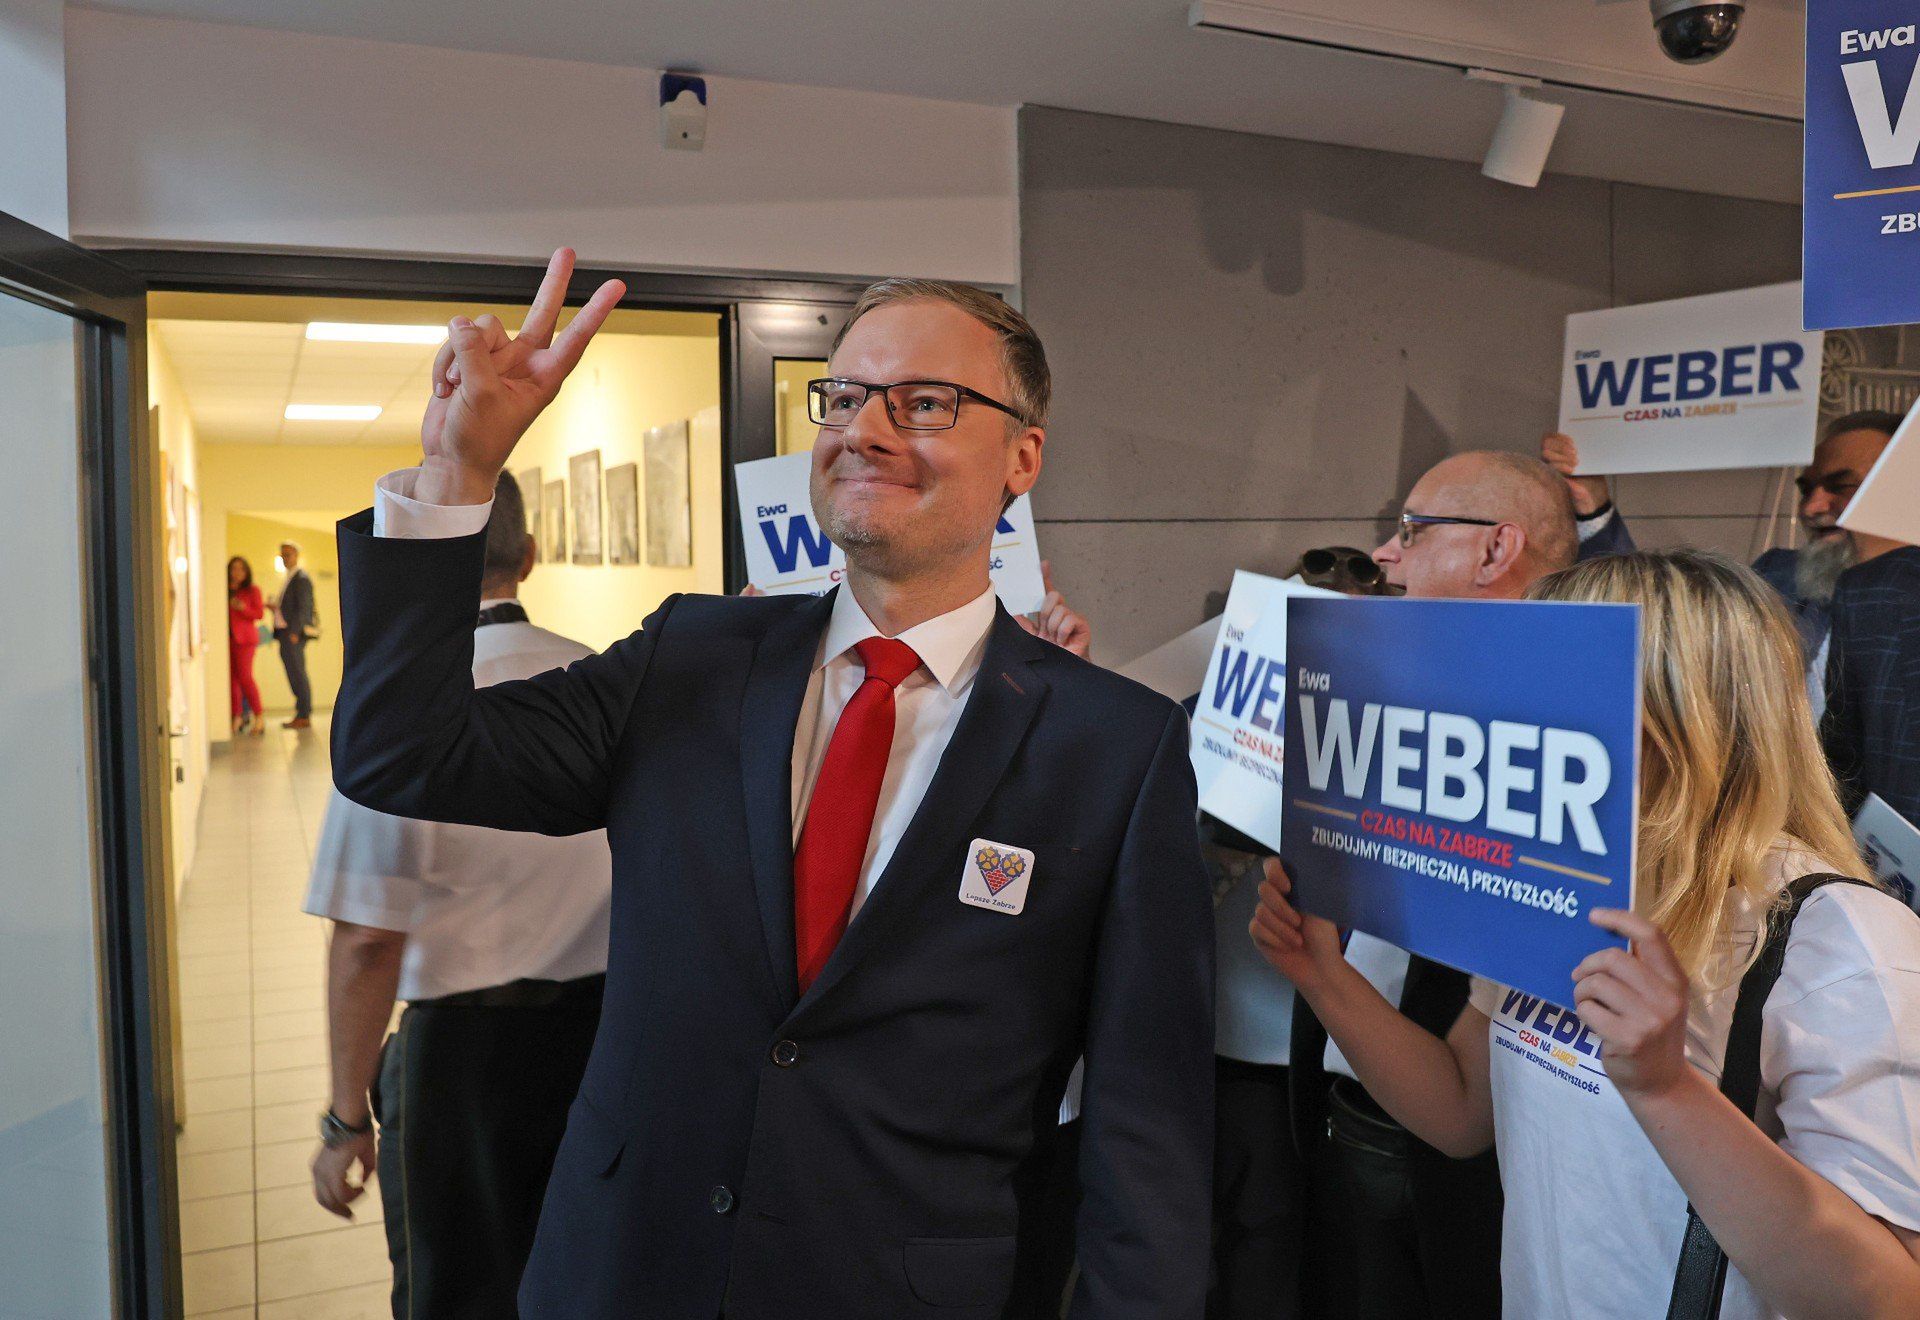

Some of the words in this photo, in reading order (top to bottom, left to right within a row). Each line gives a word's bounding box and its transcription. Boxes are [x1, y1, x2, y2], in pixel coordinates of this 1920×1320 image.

[1841, 25, 1915, 54] Ewa
[1575, 341, 1804, 409] WEBER
[1623, 409, 1659, 422] CZAS
[1661, 407, 1681, 418] NA
[1684, 402, 1738, 418] ZABRZE
[757, 504, 787, 518] Ewa
[1212, 644, 1285, 737] WE
[1299, 667, 1330, 692] Ewa
[1299, 694, 1612, 857] WEBER
[1360, 809, 1406, 841] CZAS
[1409, 817, 1436, 849] NA
[1439, 827, 1514, 868] ZABRZE
[1311, 826, 1381, 861] ZBUDUJMY
[1383, 845, 1470, 893] BEZPIECZNĄ
[1471, 869, 1579, 919] PRZYSZŁOŚĆ
[1495, 1035, 1526, 1057] ZBUDUJMY
[1525, 1051, 1557, 1077] BEZPIECZNĄ
[1557, 1069, 1600, 1095] PRZYSZŁOŚĆ
[1518, 1030, 1540, 1048] CZAS
[1539, 1039, 1551, 1054] NA
[1551, 1046, 1578, 1067] ZABRZE
